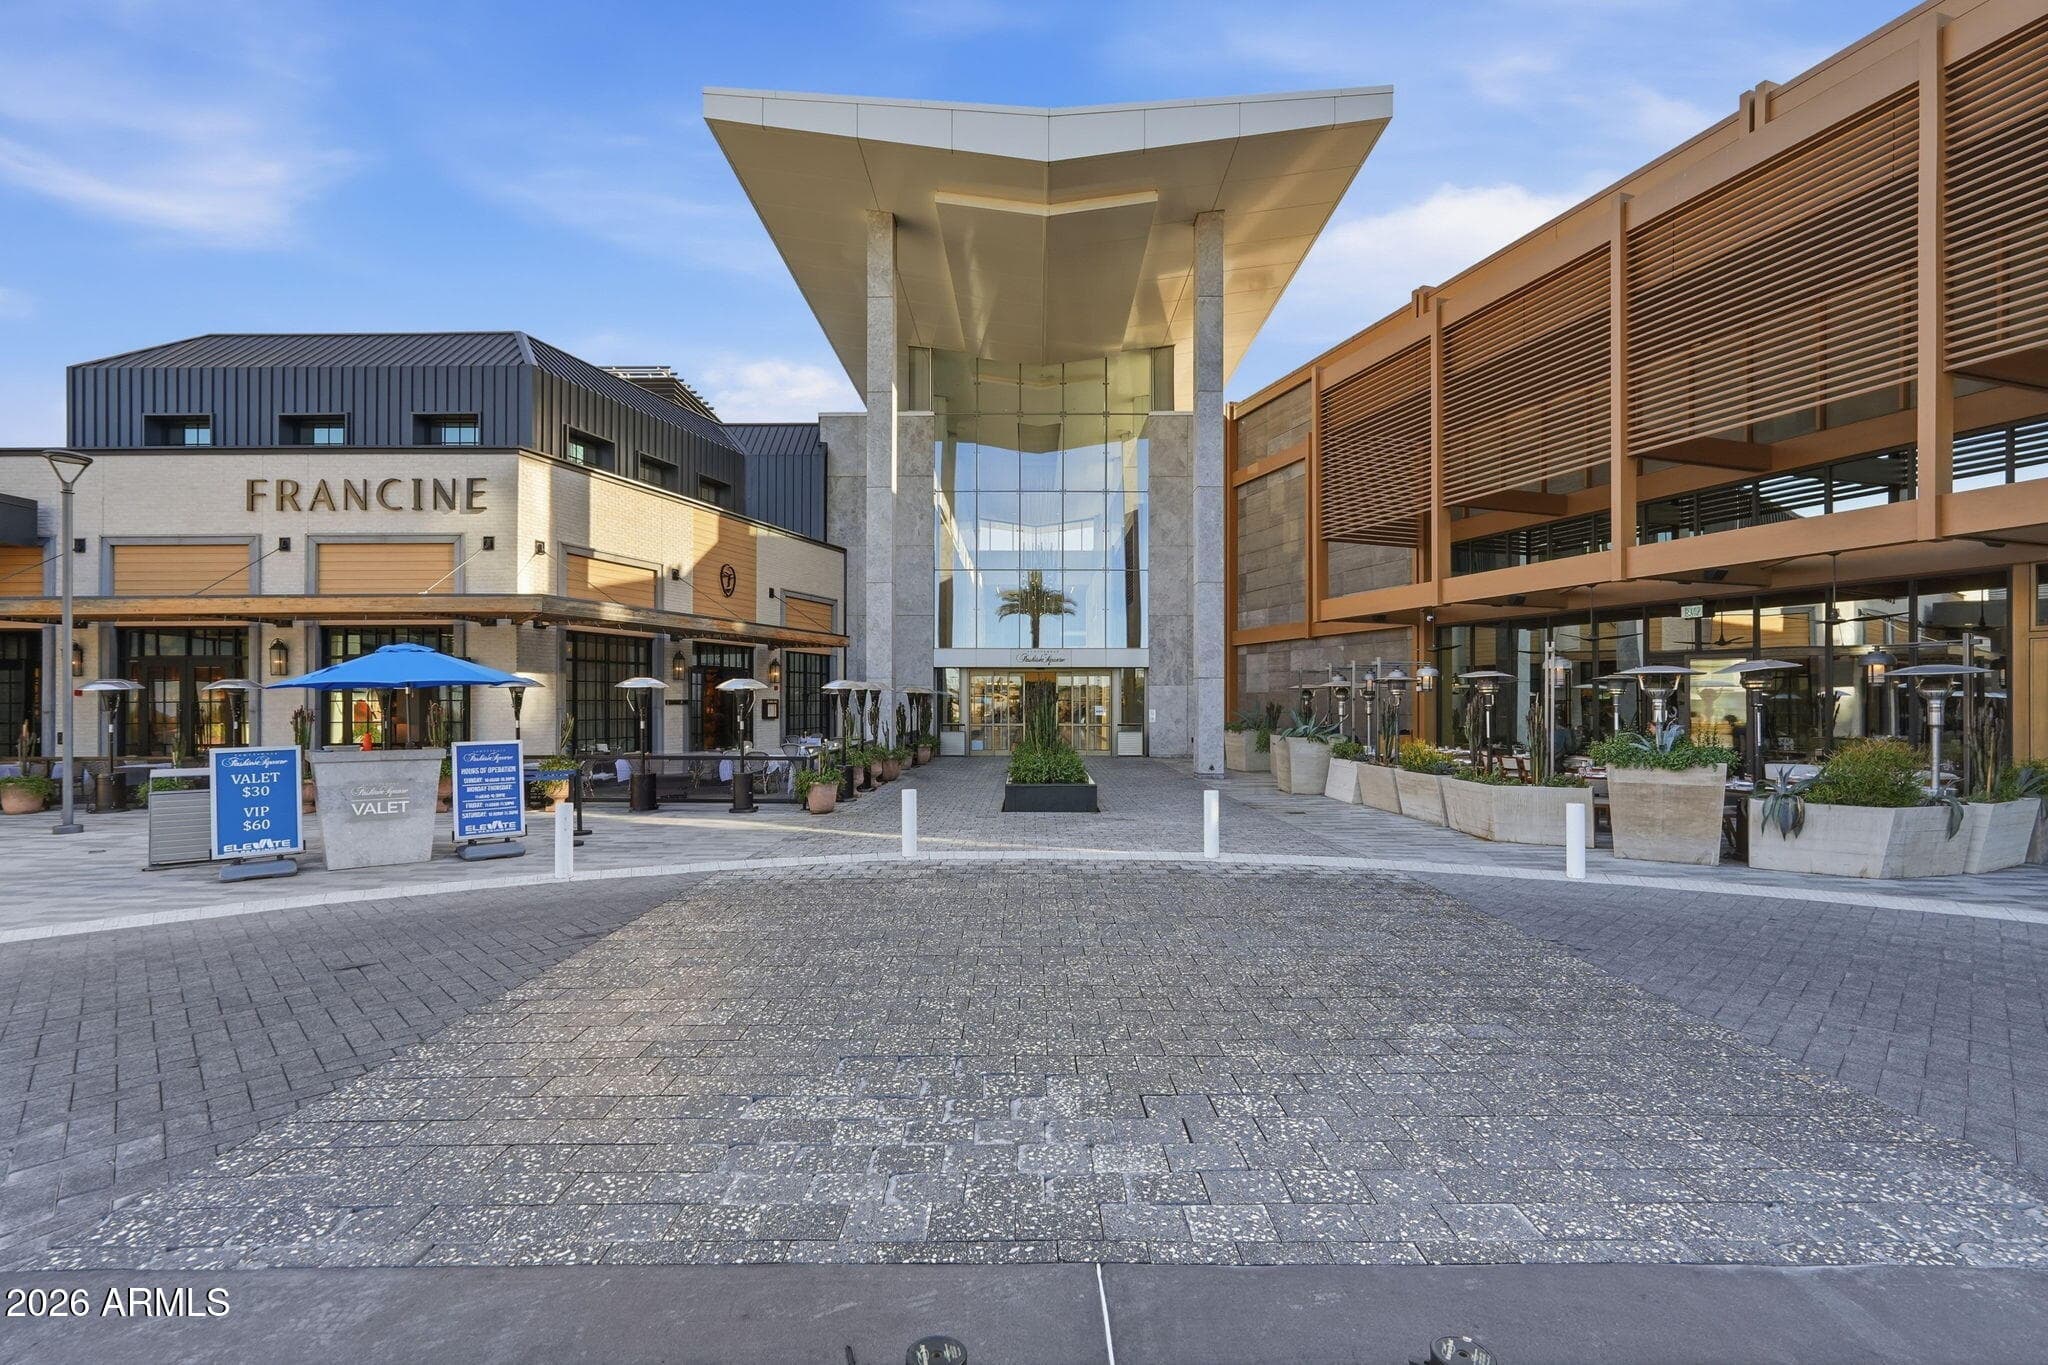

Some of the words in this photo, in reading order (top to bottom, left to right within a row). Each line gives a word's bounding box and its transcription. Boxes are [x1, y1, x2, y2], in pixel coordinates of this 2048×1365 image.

[246, 478, 487, 512] FRANCINE
[221, 757, 260, 768] Fashion
[256, 756, 288, 769] Square
[461, 767, 480, 775] HOURS
[231, 772, 280, 785] VALET
[242, 786, 270, 798] $30
[244, 806, 270, 818] VIP
[351, 800, 410, 816] VALET
[243, 819, 271, 832] $60
[465, 820, 517, 832] ELEVATE
[223, 838, 291, 853] ELEVATE
